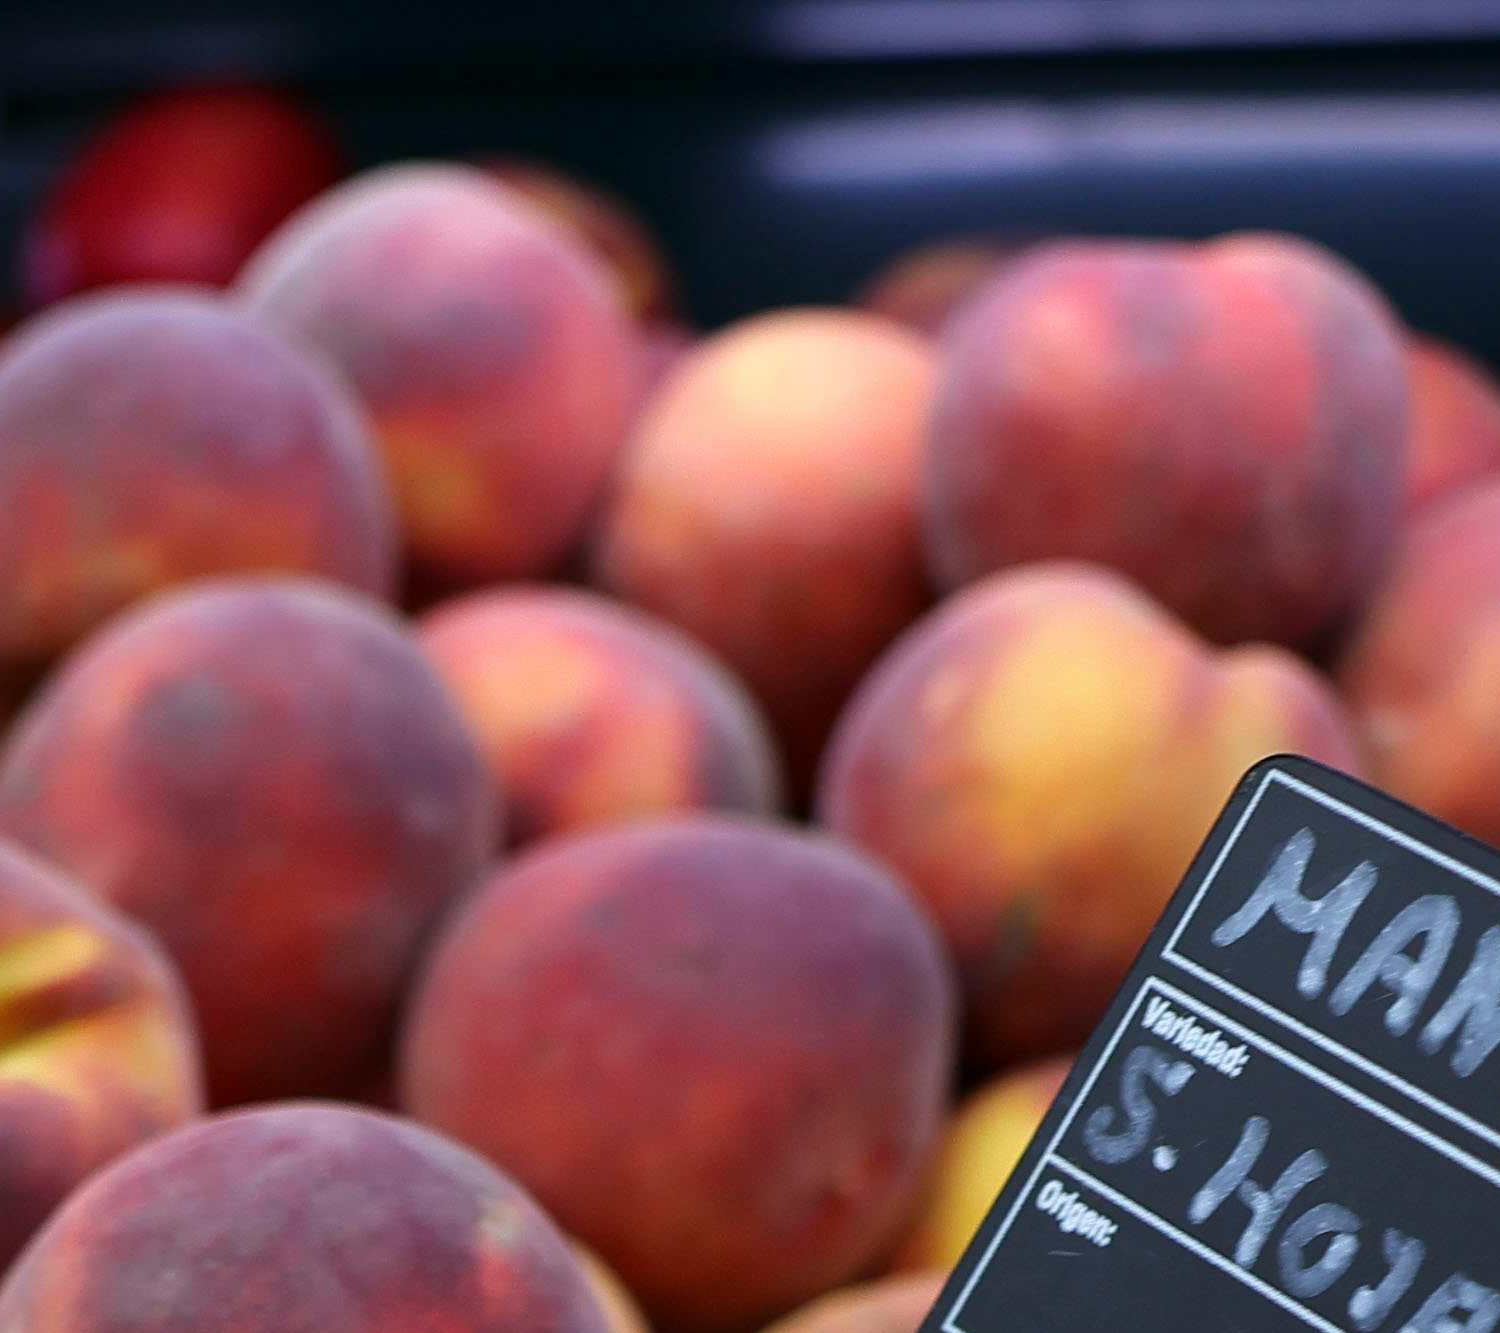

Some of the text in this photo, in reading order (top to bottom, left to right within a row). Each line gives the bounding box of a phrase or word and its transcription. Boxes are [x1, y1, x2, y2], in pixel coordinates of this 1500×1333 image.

[1140, 996, 1250, 1079] Variedad:
[1083, 1044, 1197, 1173] S.
[1035, 1179, 1119, 1247] Origen:
